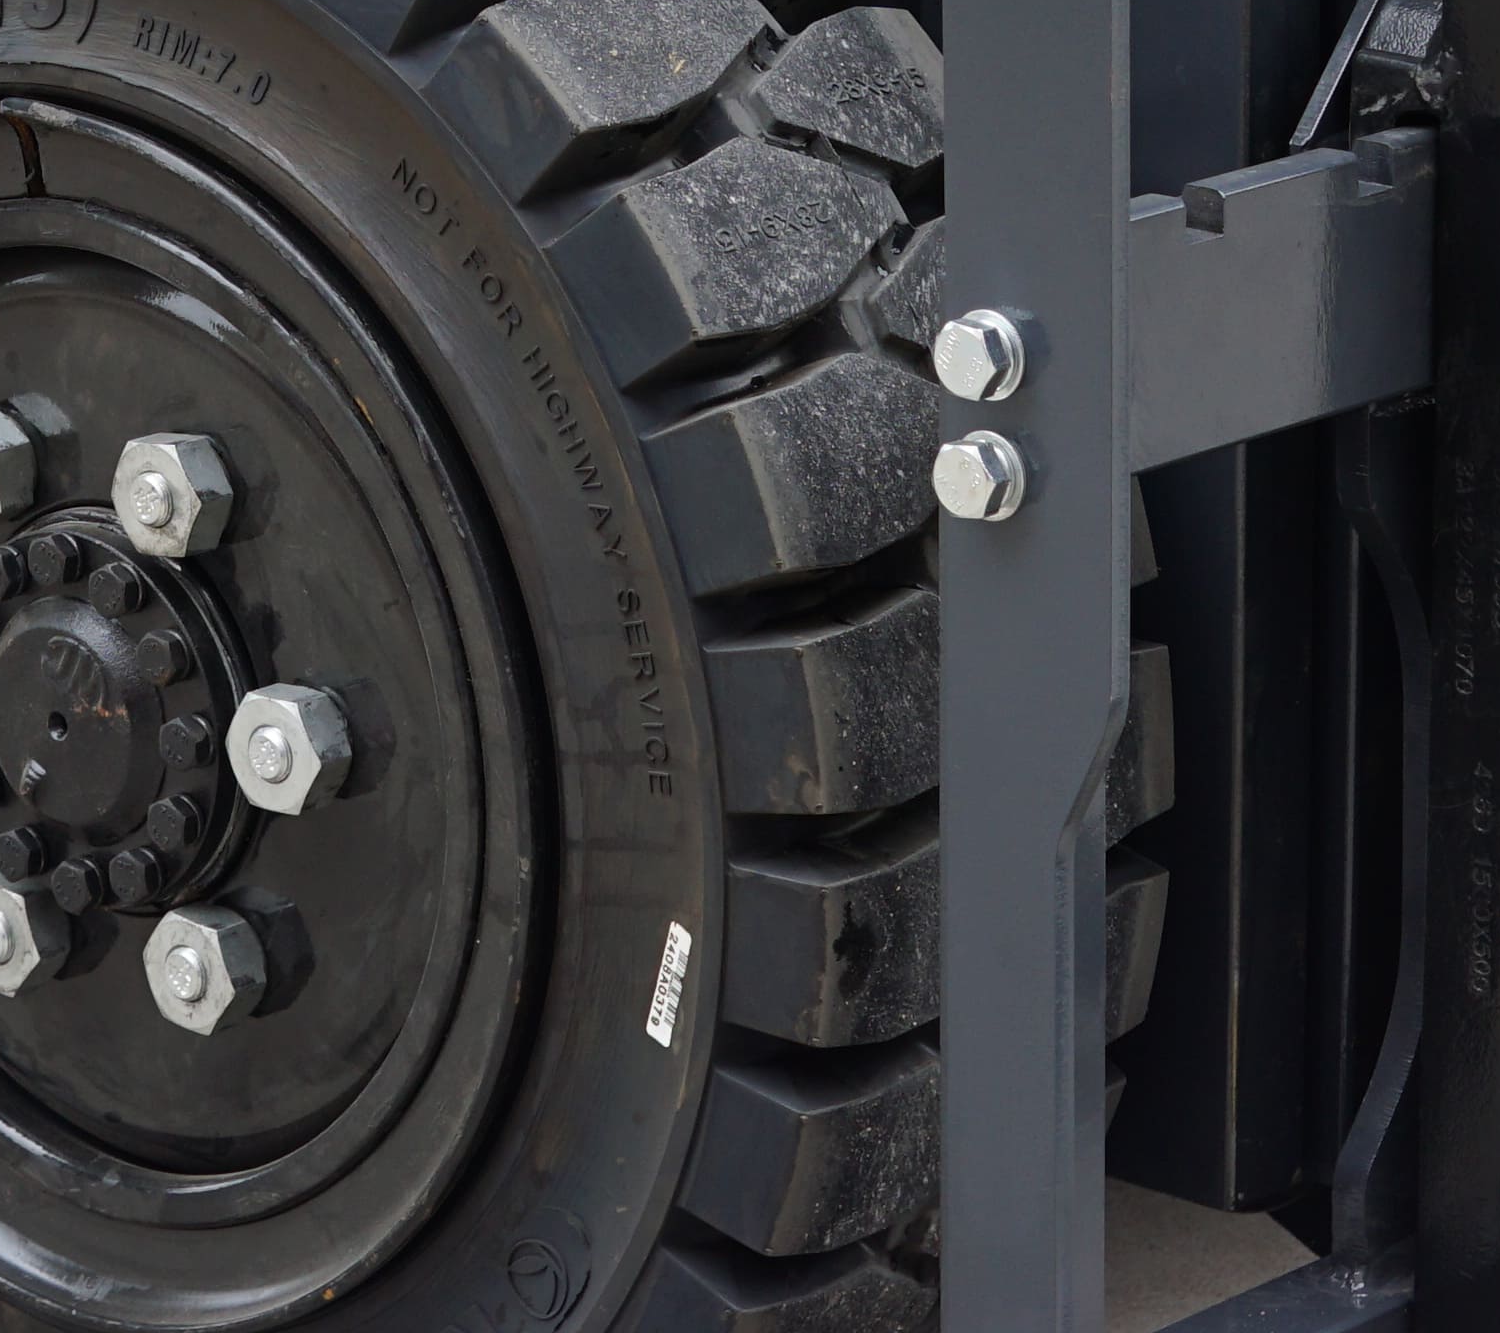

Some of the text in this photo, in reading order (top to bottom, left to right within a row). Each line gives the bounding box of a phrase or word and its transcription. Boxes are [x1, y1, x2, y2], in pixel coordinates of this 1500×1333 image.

[391, 158, 673, 797] NOT FOR HIGHWAY SERVICE
